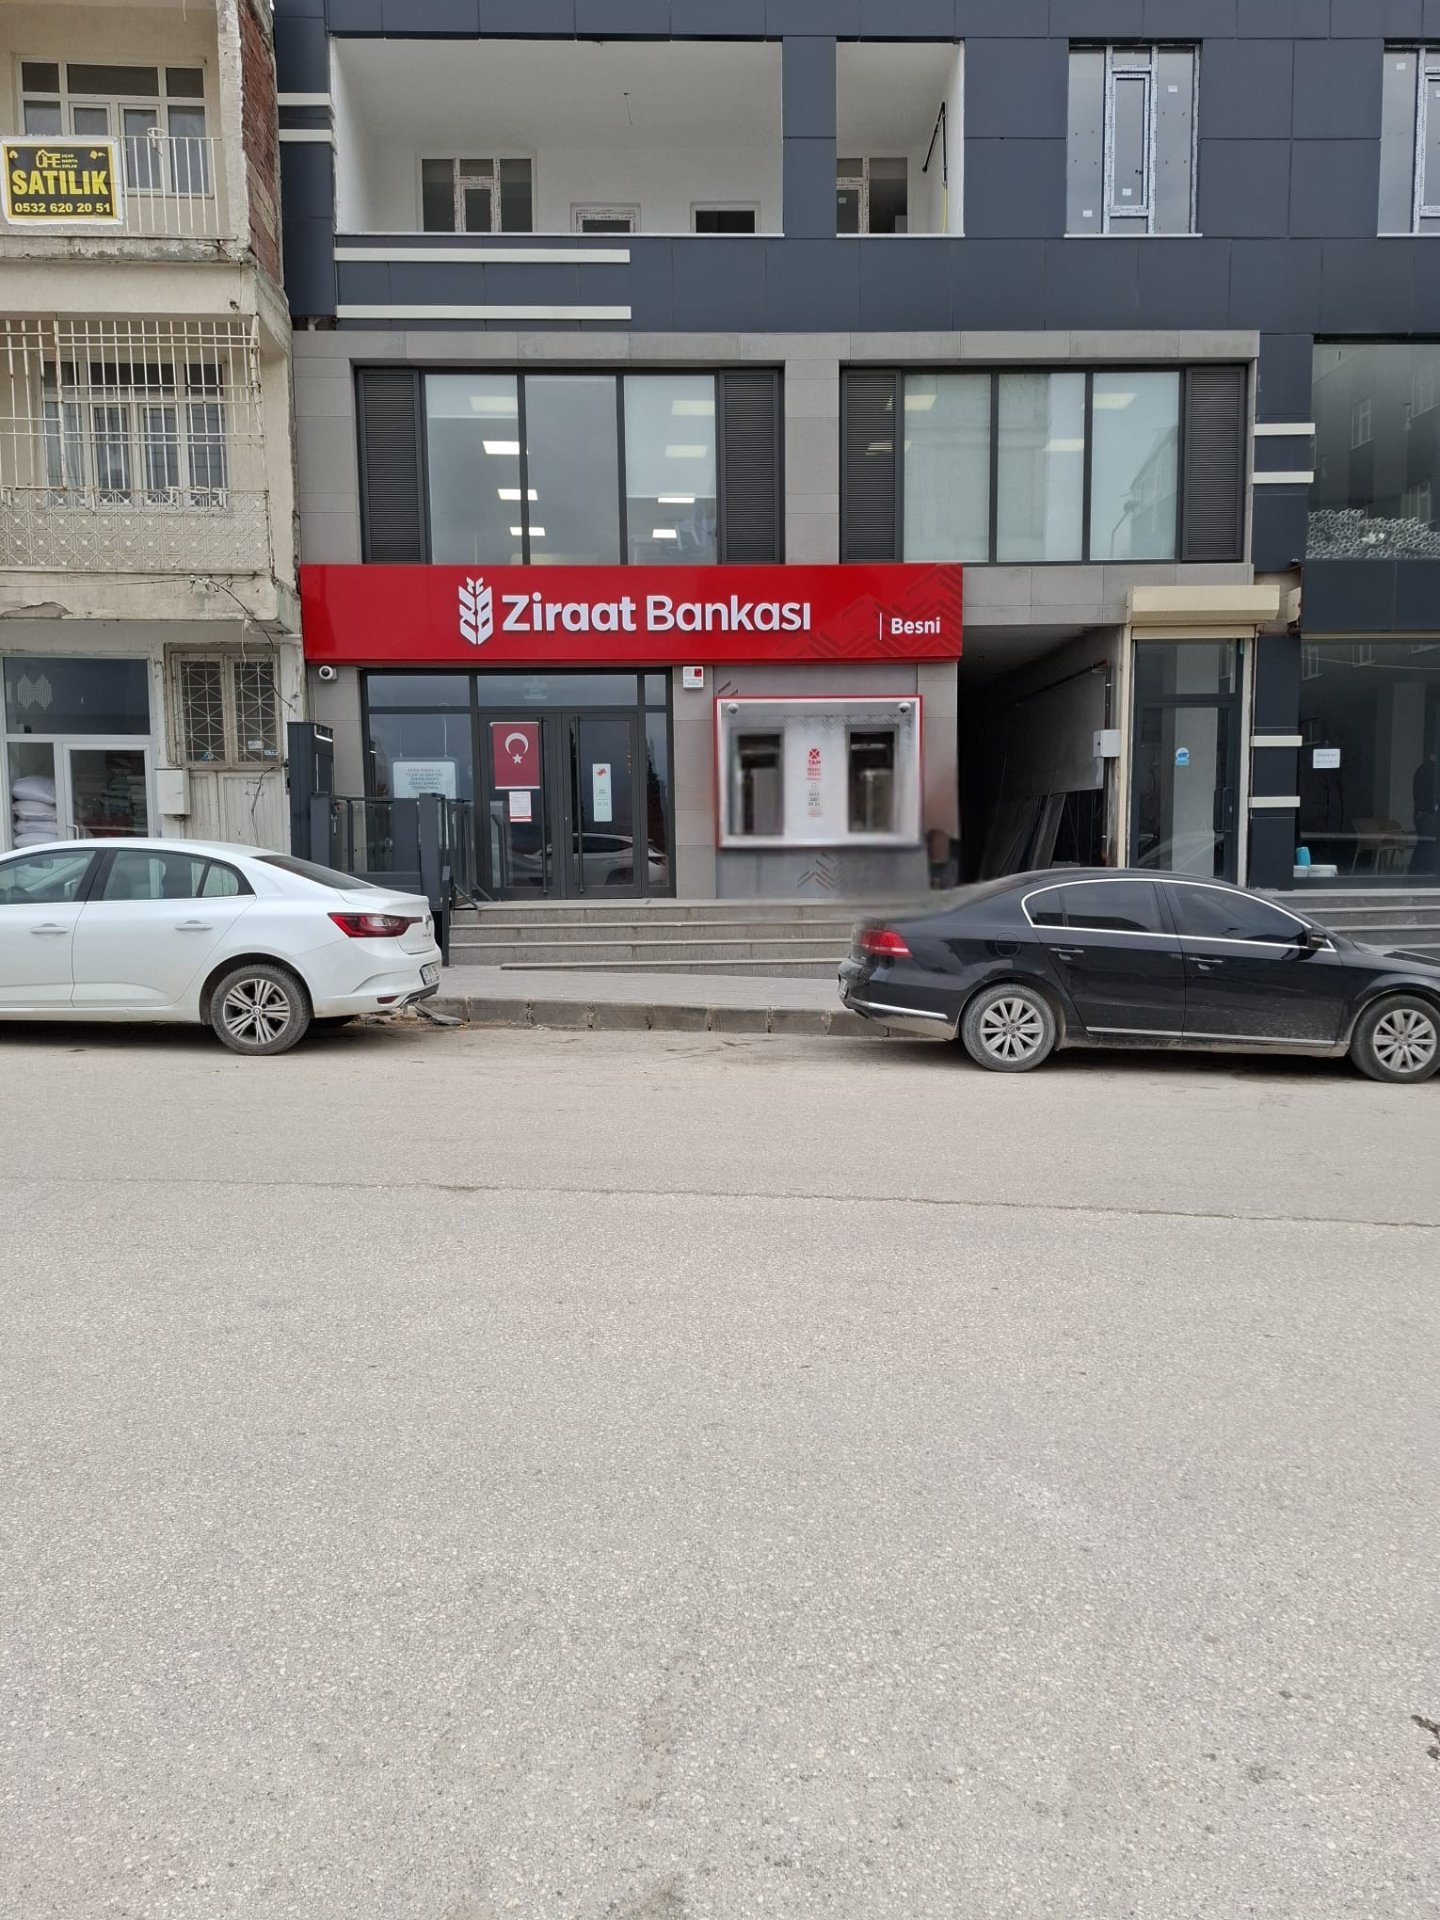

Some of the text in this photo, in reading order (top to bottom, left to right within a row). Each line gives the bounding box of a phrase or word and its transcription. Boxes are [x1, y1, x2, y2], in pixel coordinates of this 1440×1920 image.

[12, 170, 108, 195] SATILIK
[15, 202, 110, 213] 0532 620 20 51
[502, 592, 811, 632] Ziraat Bankası
[891, 616, 941, 634] Besni
